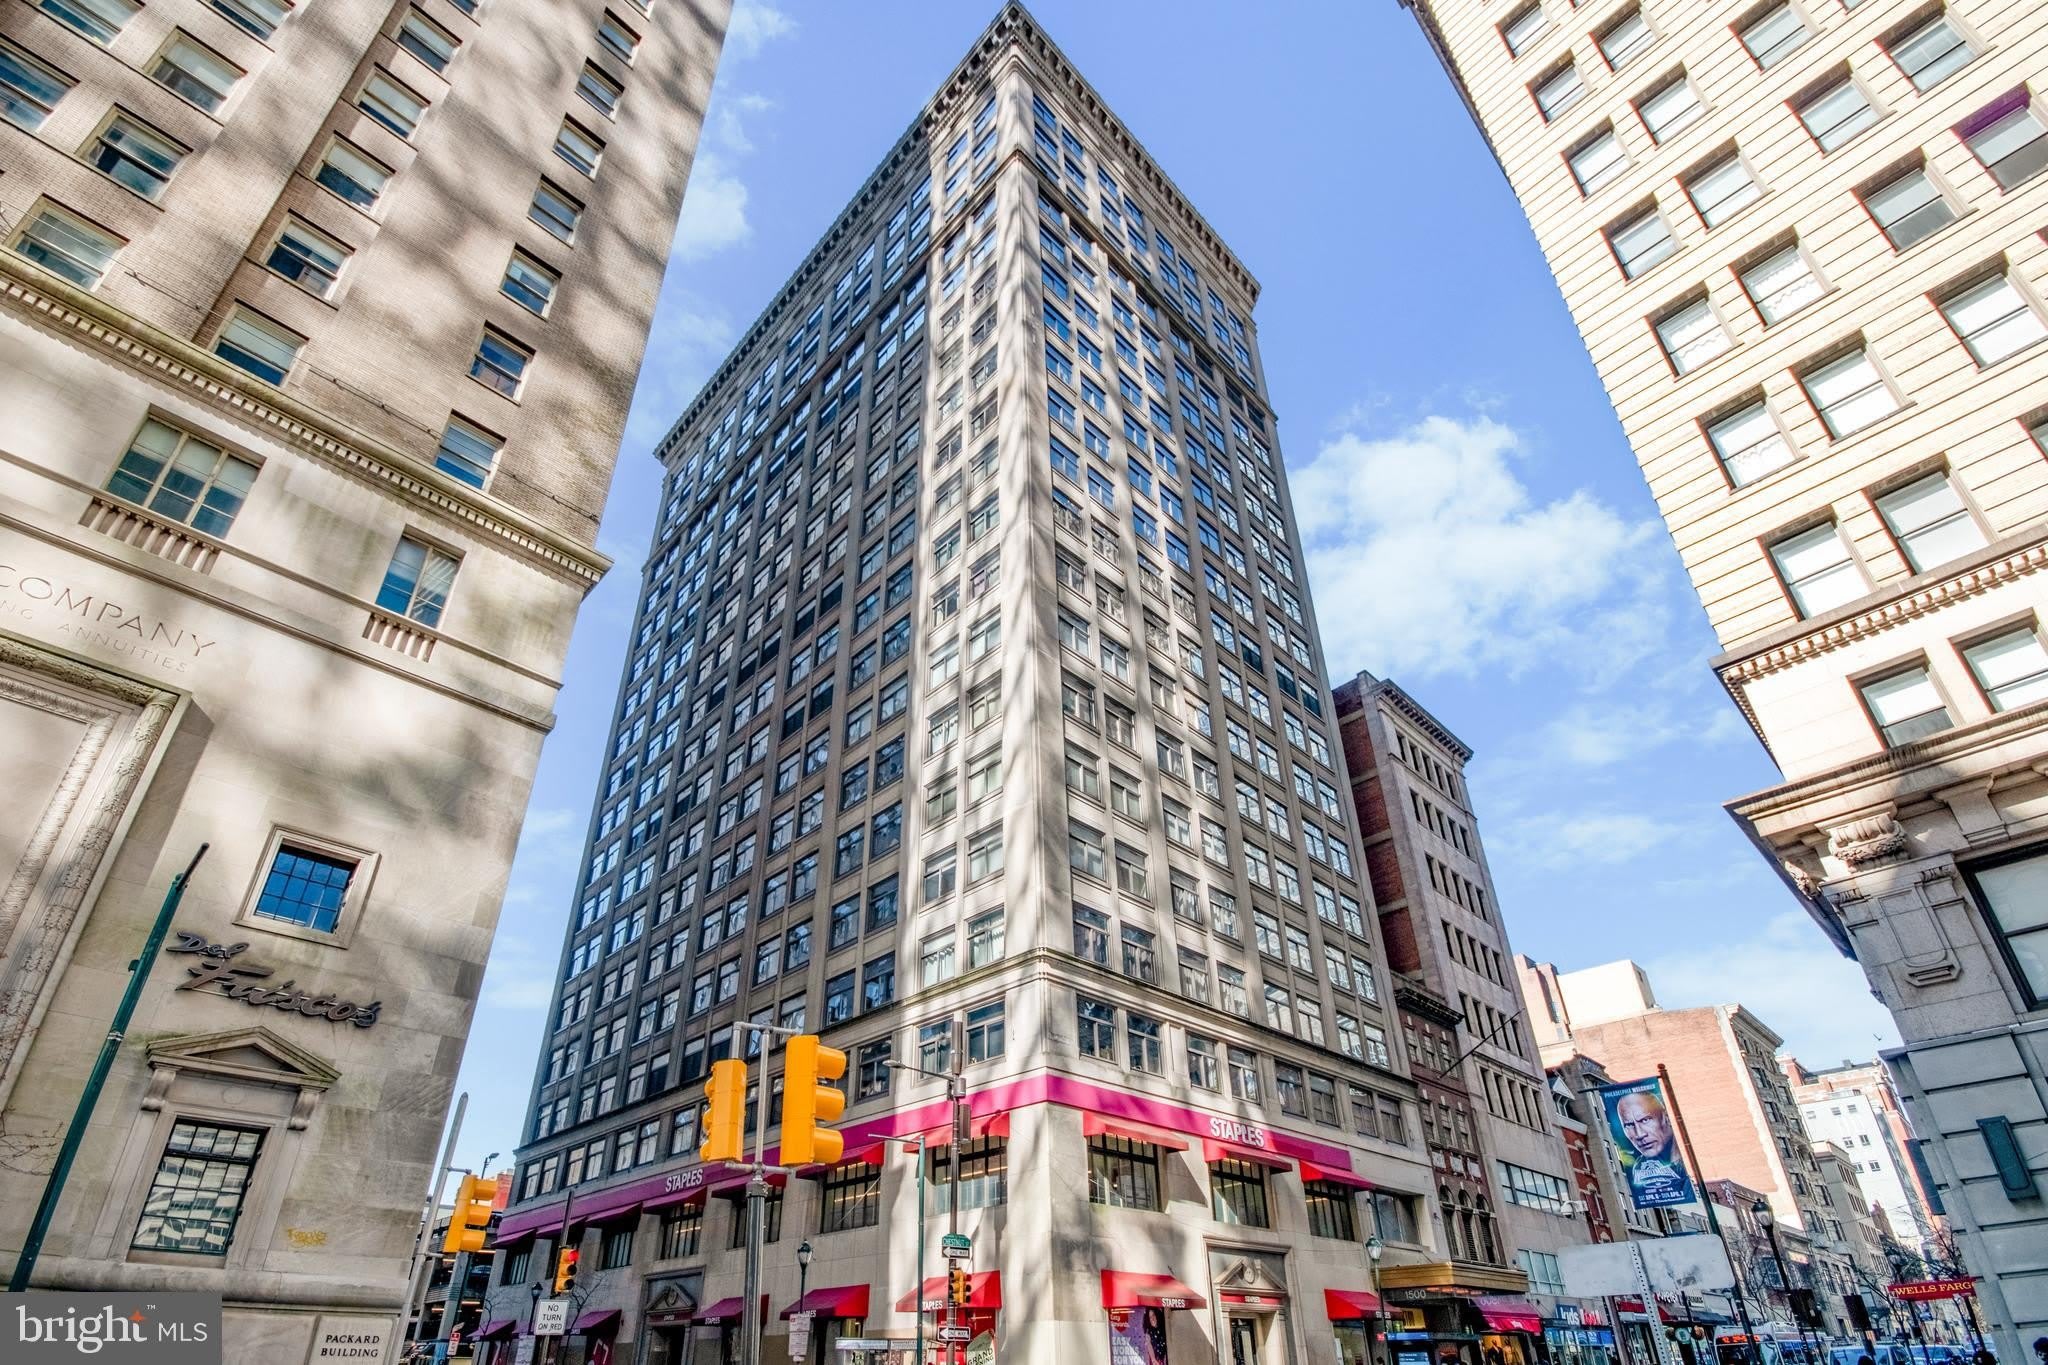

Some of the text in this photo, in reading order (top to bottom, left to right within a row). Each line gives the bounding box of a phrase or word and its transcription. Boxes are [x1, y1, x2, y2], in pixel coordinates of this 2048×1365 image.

[57, 623, 187, 673] ANNUITIES
[166, 931, 250, 960] Del
[1209, 1117, 1265, 1148] STAPLES
[665, 1168, 704, 1192] STAPLES
[1405, 1289, 1427, 1299] 1500
[1894, 1281, 1973, 1295] WELLS FARG
[920, 1300, 943, 1311] TAPLES
[1161, 1298, 1186, 1308] STAPLES
[325, 1335, 380, 1344] PACKARD
[321, 1347, 378, 1358] BUILDING
[968, 1348, 994, 1365] GRAND
